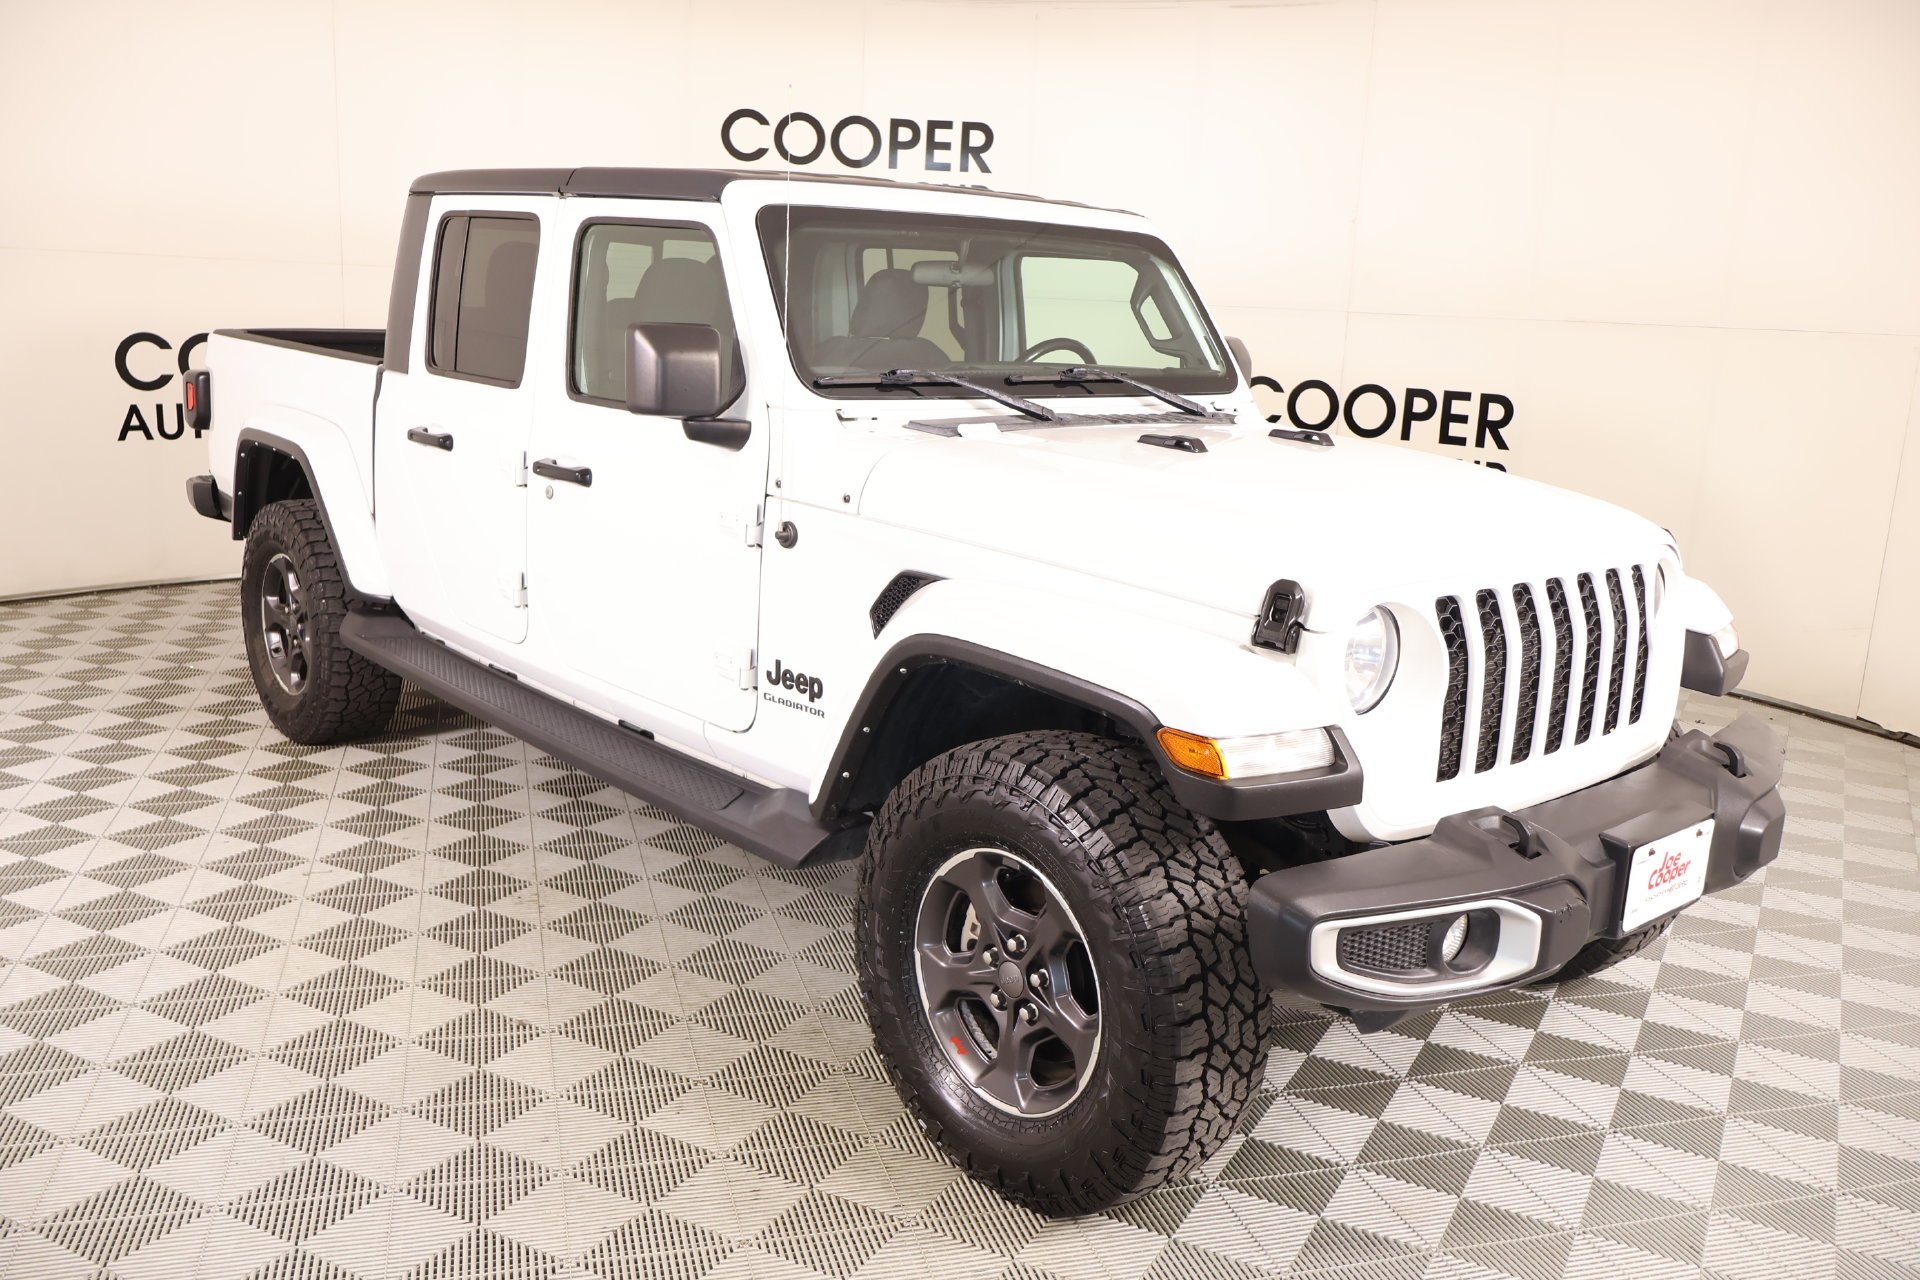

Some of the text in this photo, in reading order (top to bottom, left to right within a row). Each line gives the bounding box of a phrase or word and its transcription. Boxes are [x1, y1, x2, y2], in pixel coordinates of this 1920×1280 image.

[721, 108, 994, 173] COOPER
[117, 403, 202, 441] AU
[766, 659, 823, 703] Jeep
[763, 692, 825, 719] GLADIATOR
[1648, 860, 1691, 890] Cooper
[1659, 851, 1681, 873] Joe
